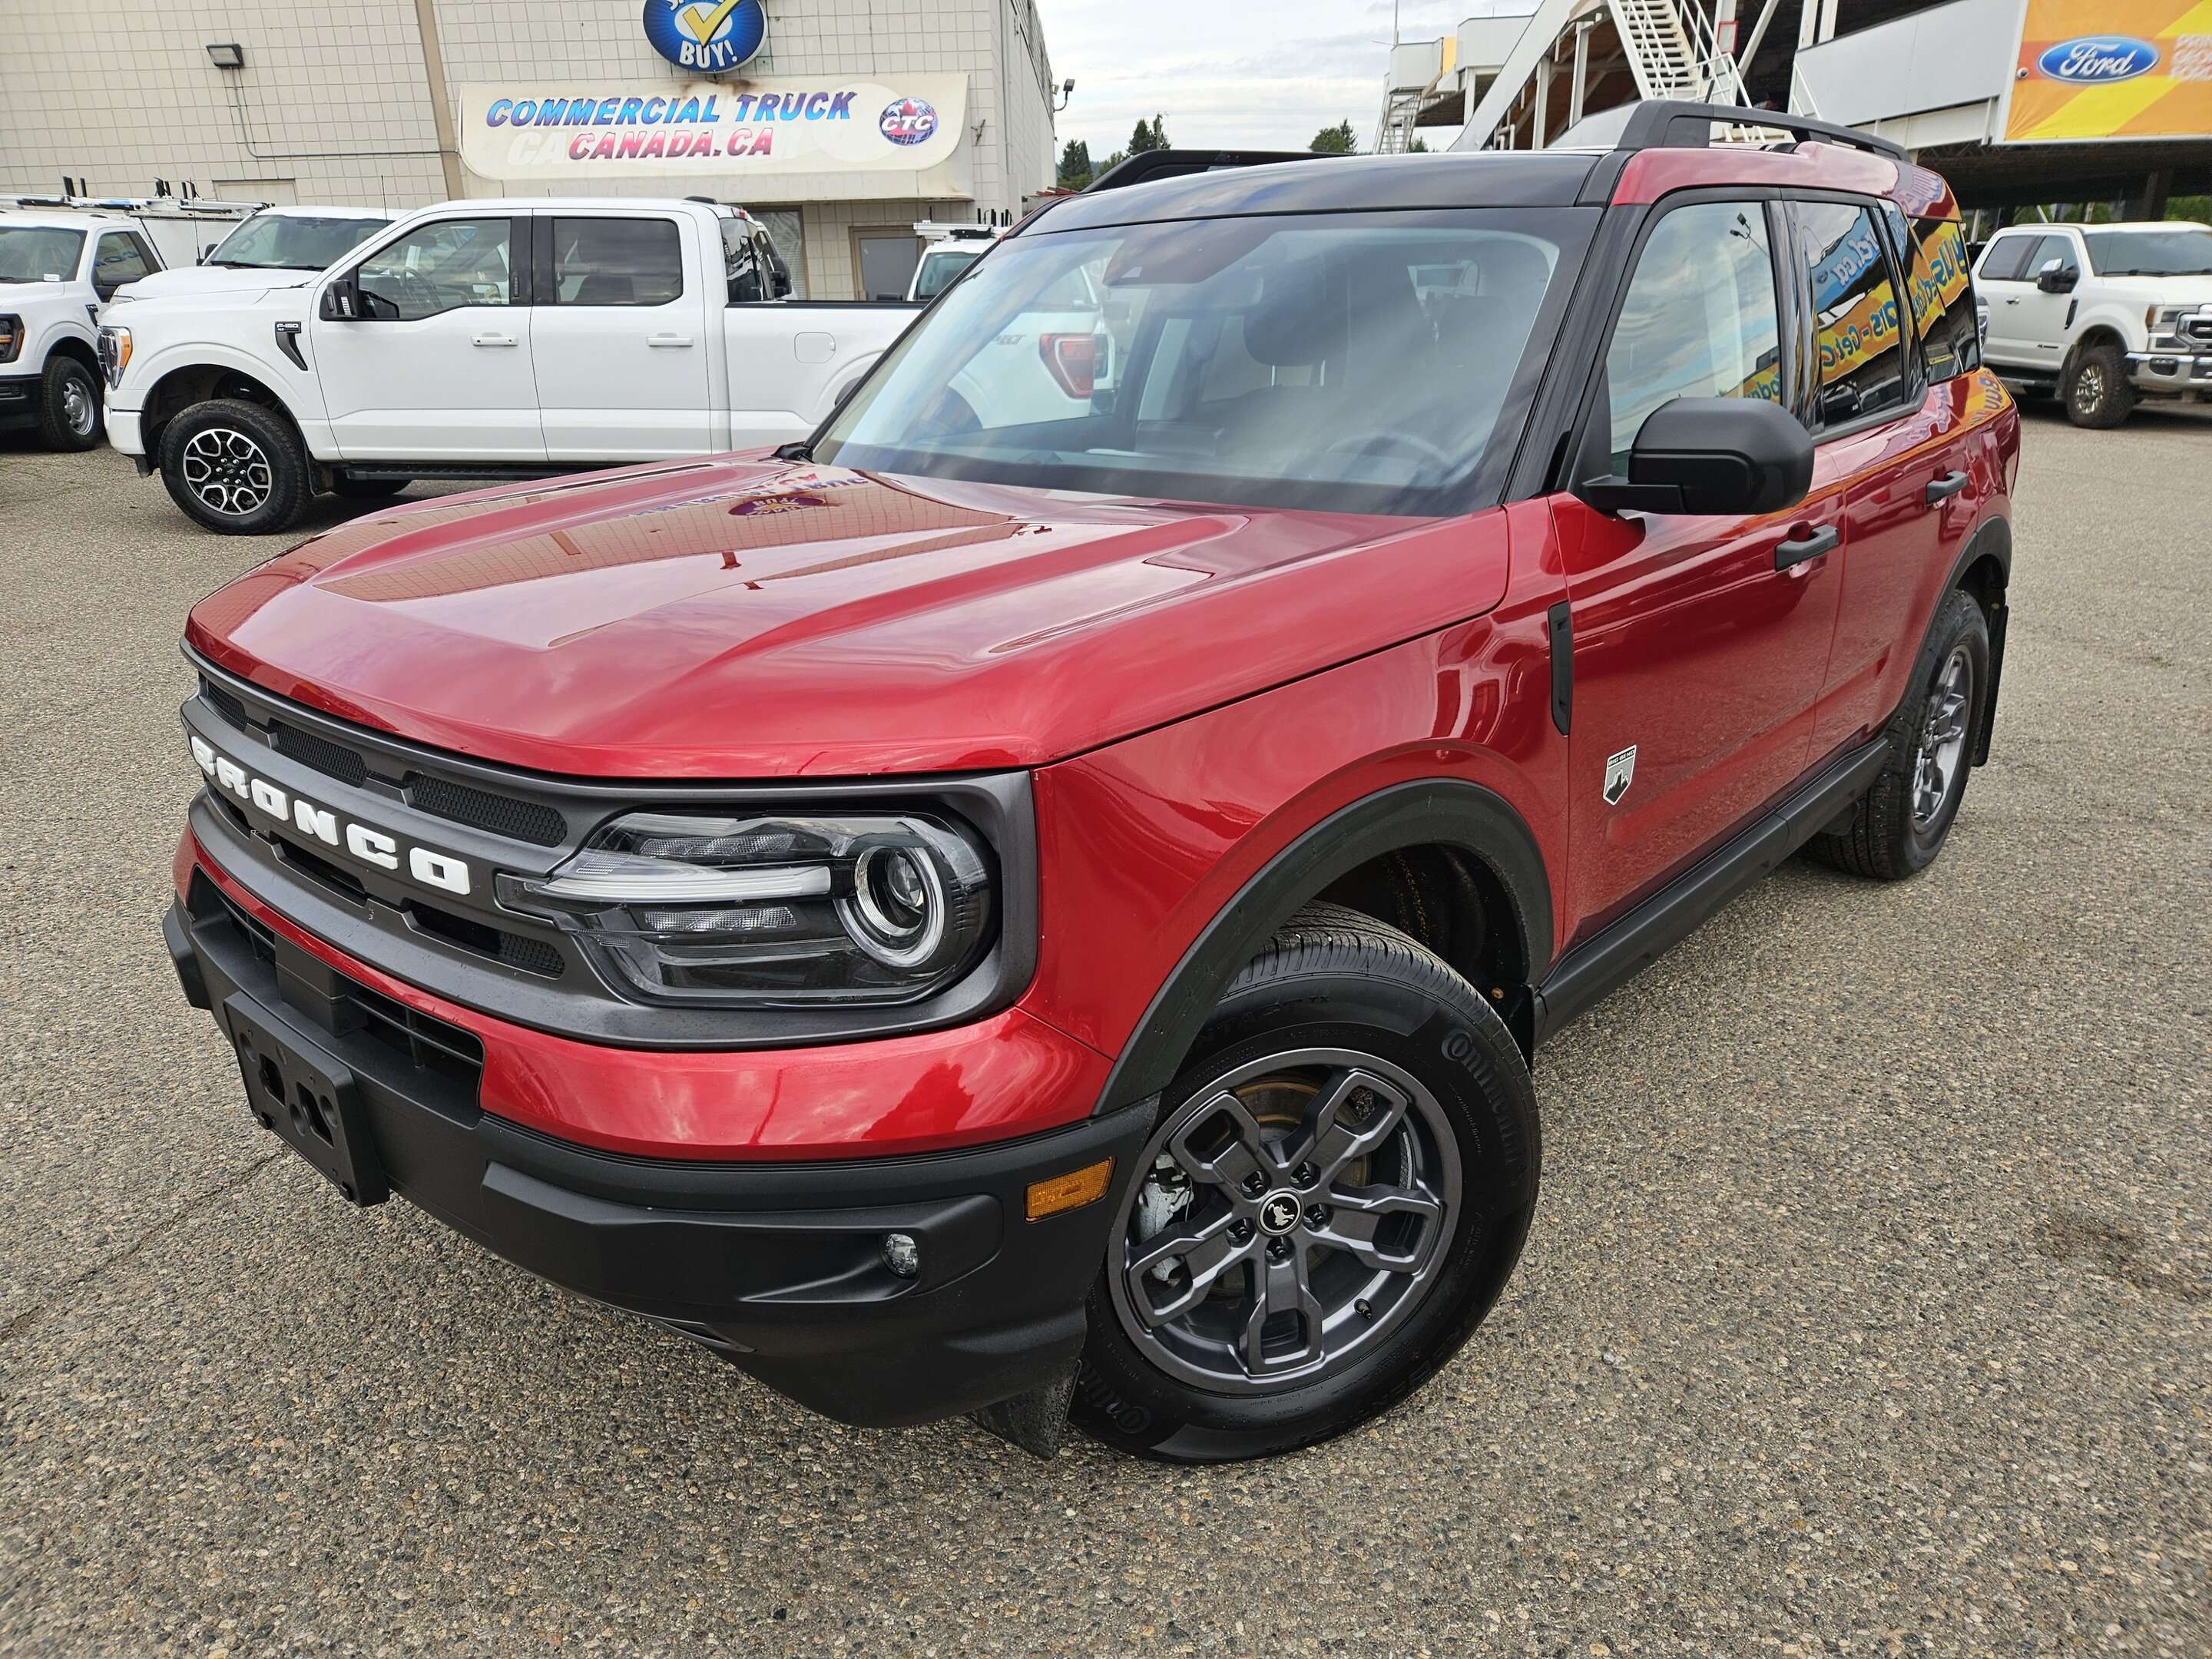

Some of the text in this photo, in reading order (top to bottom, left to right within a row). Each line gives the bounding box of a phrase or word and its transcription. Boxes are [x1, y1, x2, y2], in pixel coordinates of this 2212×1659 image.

[679, 40, 738, 68] BUY!
[2059, 43, 2138, 76] Ford
[486, 91, 858, 128] COMMERCIAL TRUCK
[881, 114, 934, 132] CTC
[568, 127, 773, 161] CANADA.CA
[190, 735, 472, 896] BRONCO
